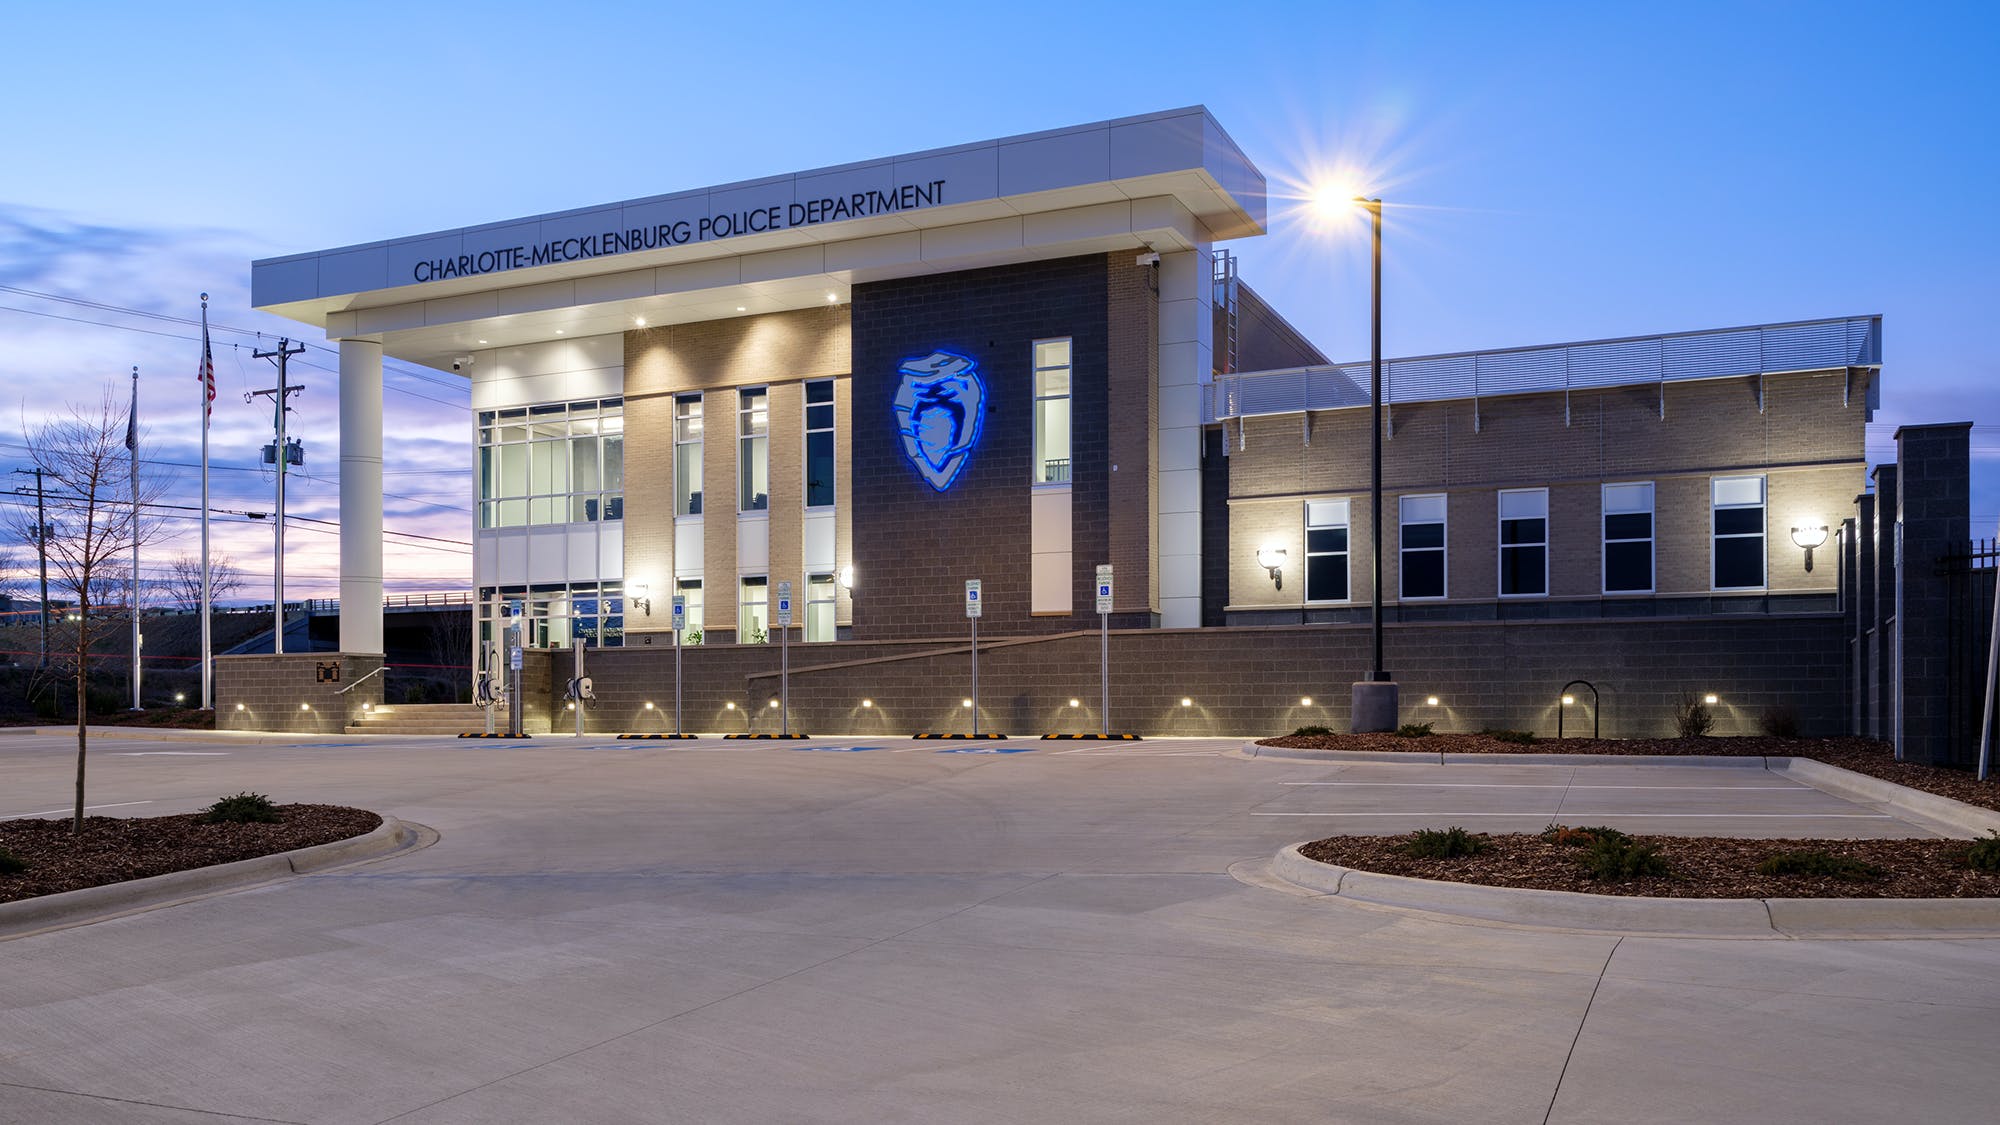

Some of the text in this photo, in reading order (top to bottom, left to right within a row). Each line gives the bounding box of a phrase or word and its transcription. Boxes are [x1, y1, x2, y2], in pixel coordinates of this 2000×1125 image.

[414, 180, 946, 283] CHARLOTTE-MECKLENBURG POLICE DEPARTMENT
